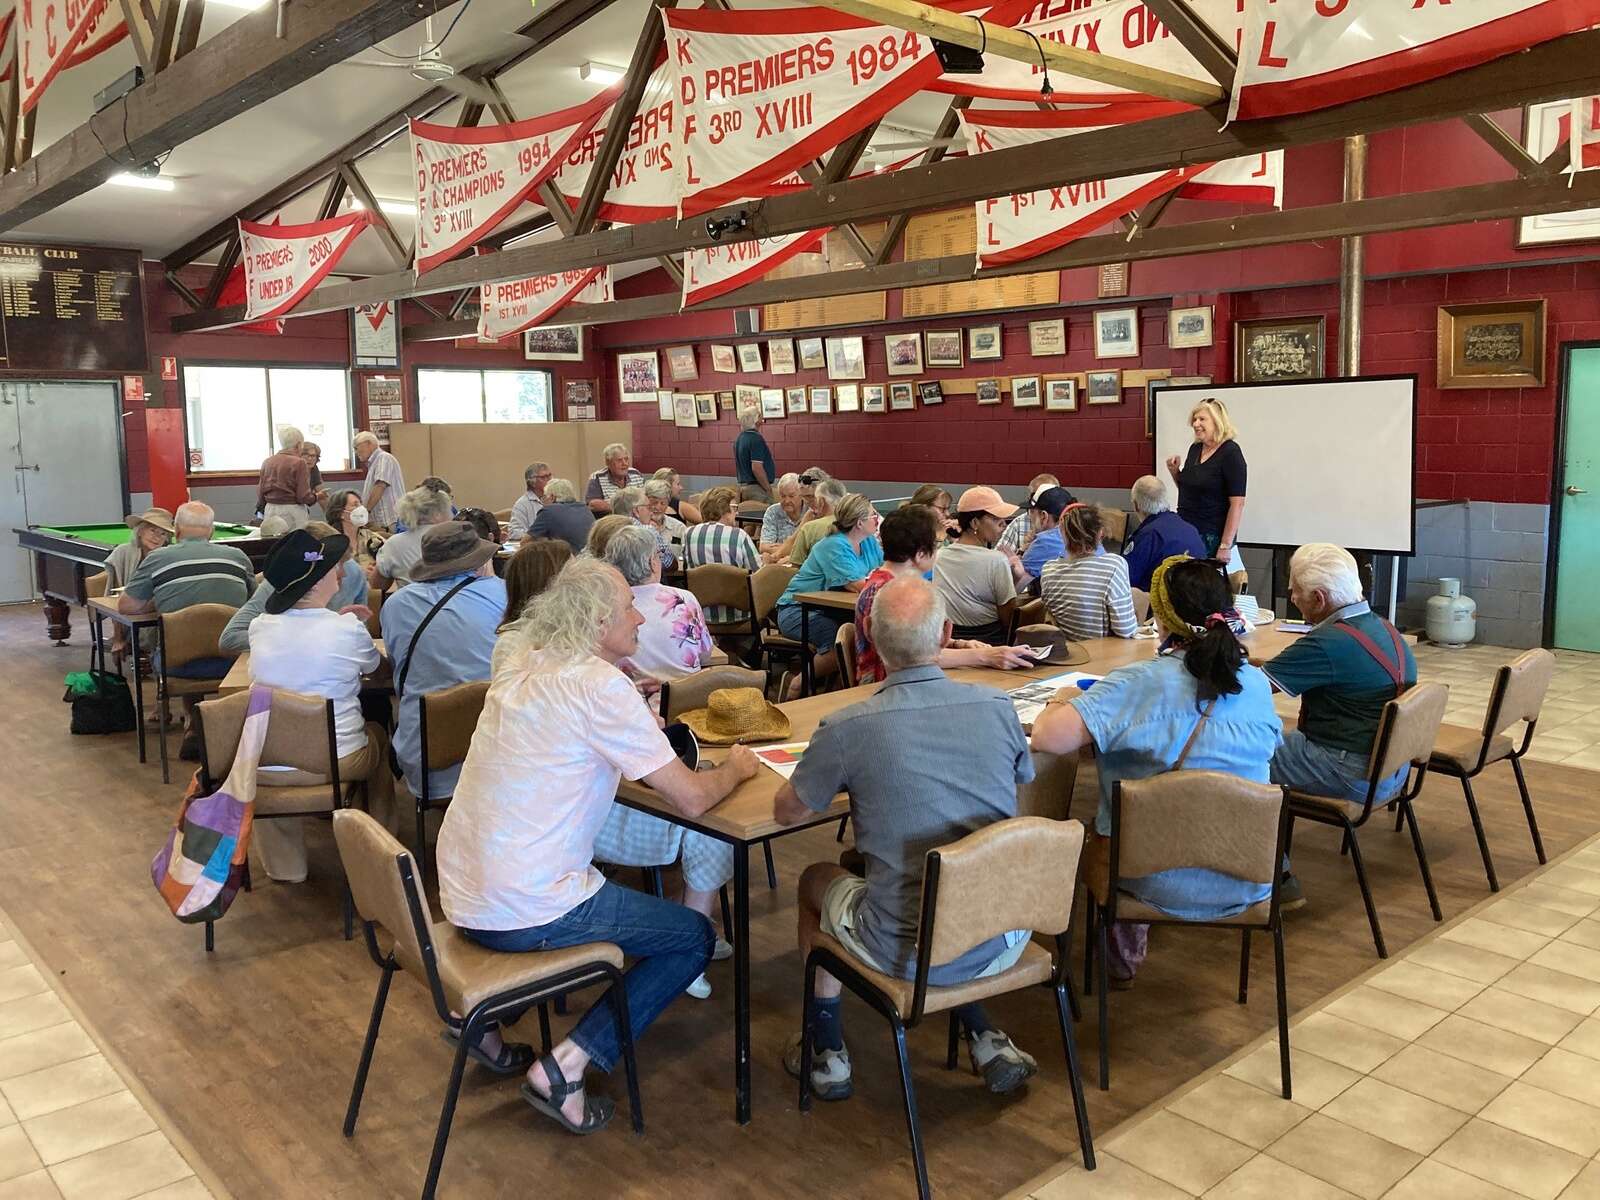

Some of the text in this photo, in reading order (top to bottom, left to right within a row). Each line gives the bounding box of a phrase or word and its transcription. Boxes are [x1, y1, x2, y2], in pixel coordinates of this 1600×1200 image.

[705, 31, 922, 100] PREMIERS 1984
[708, 92, 813, 145] 3RD XVIII
[430, 136, 551, 184] PREMIERS 1994
[443, 170, 505, 208] CHAMPIONS
[1050, 180, 1106, 210] XVIII
[450, 208, 473, 232] XVIII
[0, 246, 78, 259] BALL CLUB
[256, 236, 332, 271] PREMIERS 2000
[259, 275, 294, 299] UNDER 18
[497, 273, 558, 303] PREMIERS
